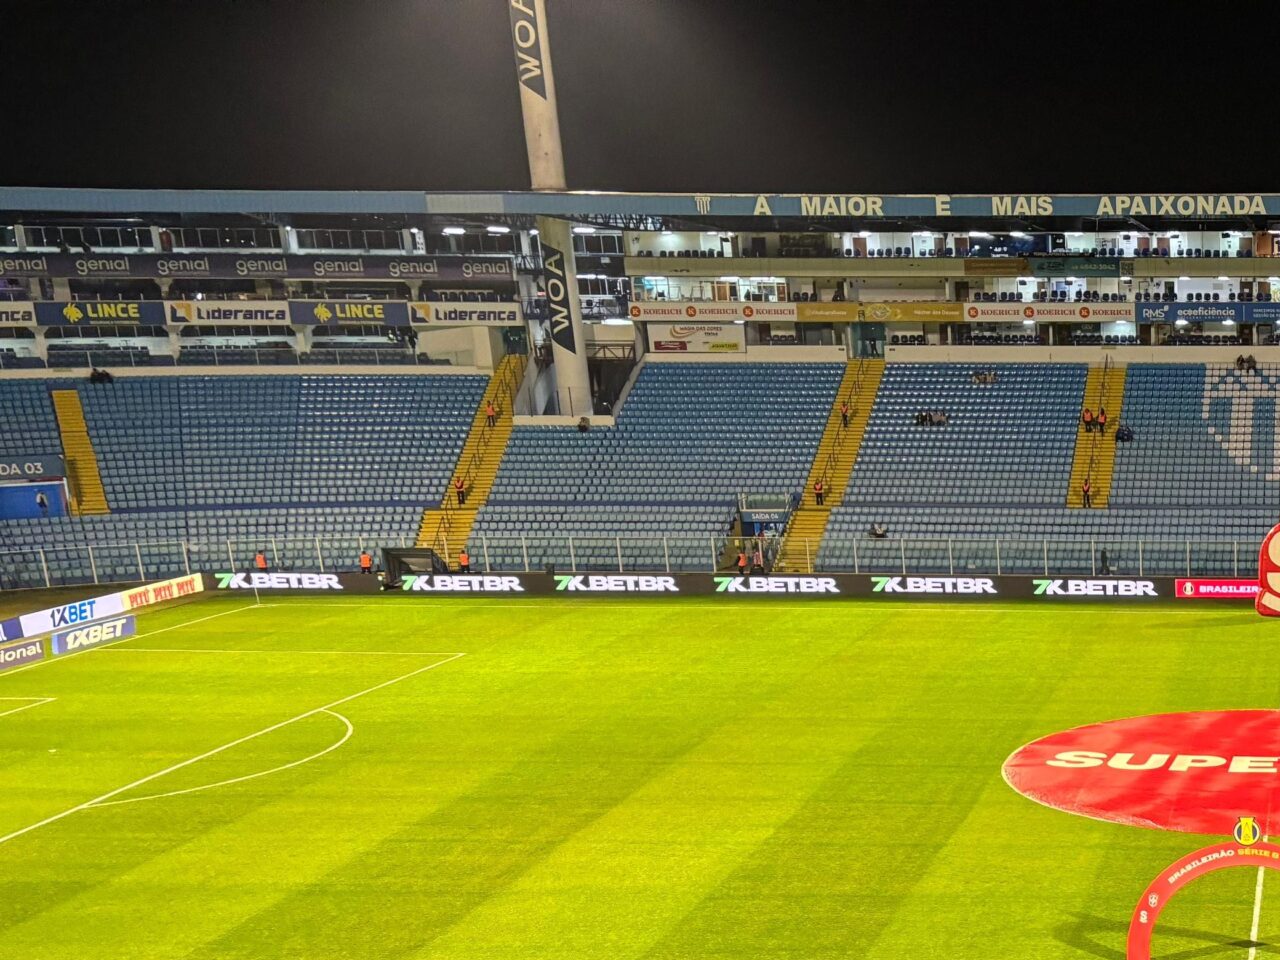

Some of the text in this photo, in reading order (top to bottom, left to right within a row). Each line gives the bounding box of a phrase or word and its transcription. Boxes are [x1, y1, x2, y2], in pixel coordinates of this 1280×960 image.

[754, 196, 772, 215] A
[801, 196, 883, 215] MAIOR
[935, 196, 951, 215] E
[992, 196, 1053, 215] MAIS
[1096, 195, 1267, 215] APAIXONADA
[75, 257, 129, 275] genial
[157, 256, 210, 275] genial
[236, 258, 287, 276] genial
[313, 258, 364, 276] genial
[389, 258, 438, 277] genial
[462, 258, 510, 277] genial
[545, 253, 569, 334] WOA
[87, 303, 140, 318] LINCE
[335, 303, 385, 318] LINCE
[643, 308, 682, 316] KOERICH
[699, 308, 738, 316] KOERICH
[756, 308, 795, 316] KOERICH
[1143, 308, 1165, 319] RMS
[24, 462, 43, 474] 03
[50, 600, 96, 628] 1XBET
[66, 618, 126, 650] 1XBET
[1168, 849, 1235, 884] BRASILEIRÃO
[1237, 847, 1270, 857] SÉRIE
